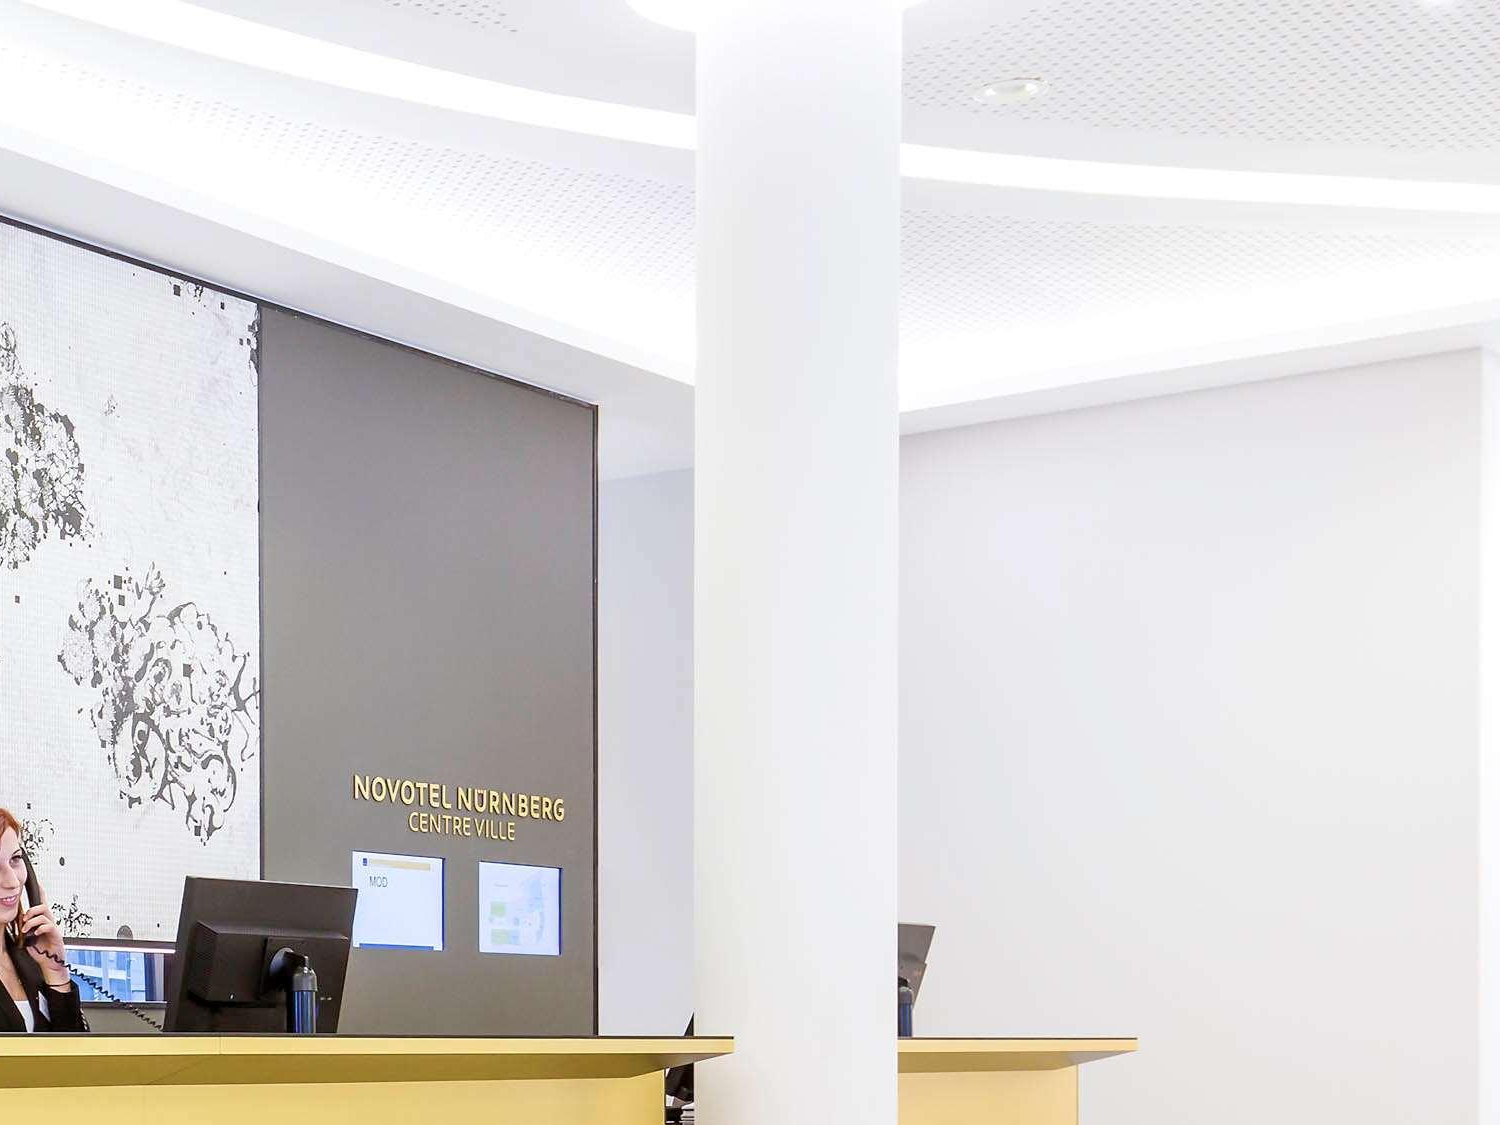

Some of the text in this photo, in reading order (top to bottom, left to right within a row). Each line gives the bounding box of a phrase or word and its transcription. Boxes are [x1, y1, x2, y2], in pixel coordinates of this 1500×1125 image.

[354, 774, 565, 822] NOVOTEL NÜRNBERG
[408, 811, 516, 841] CENTRE VILLE
